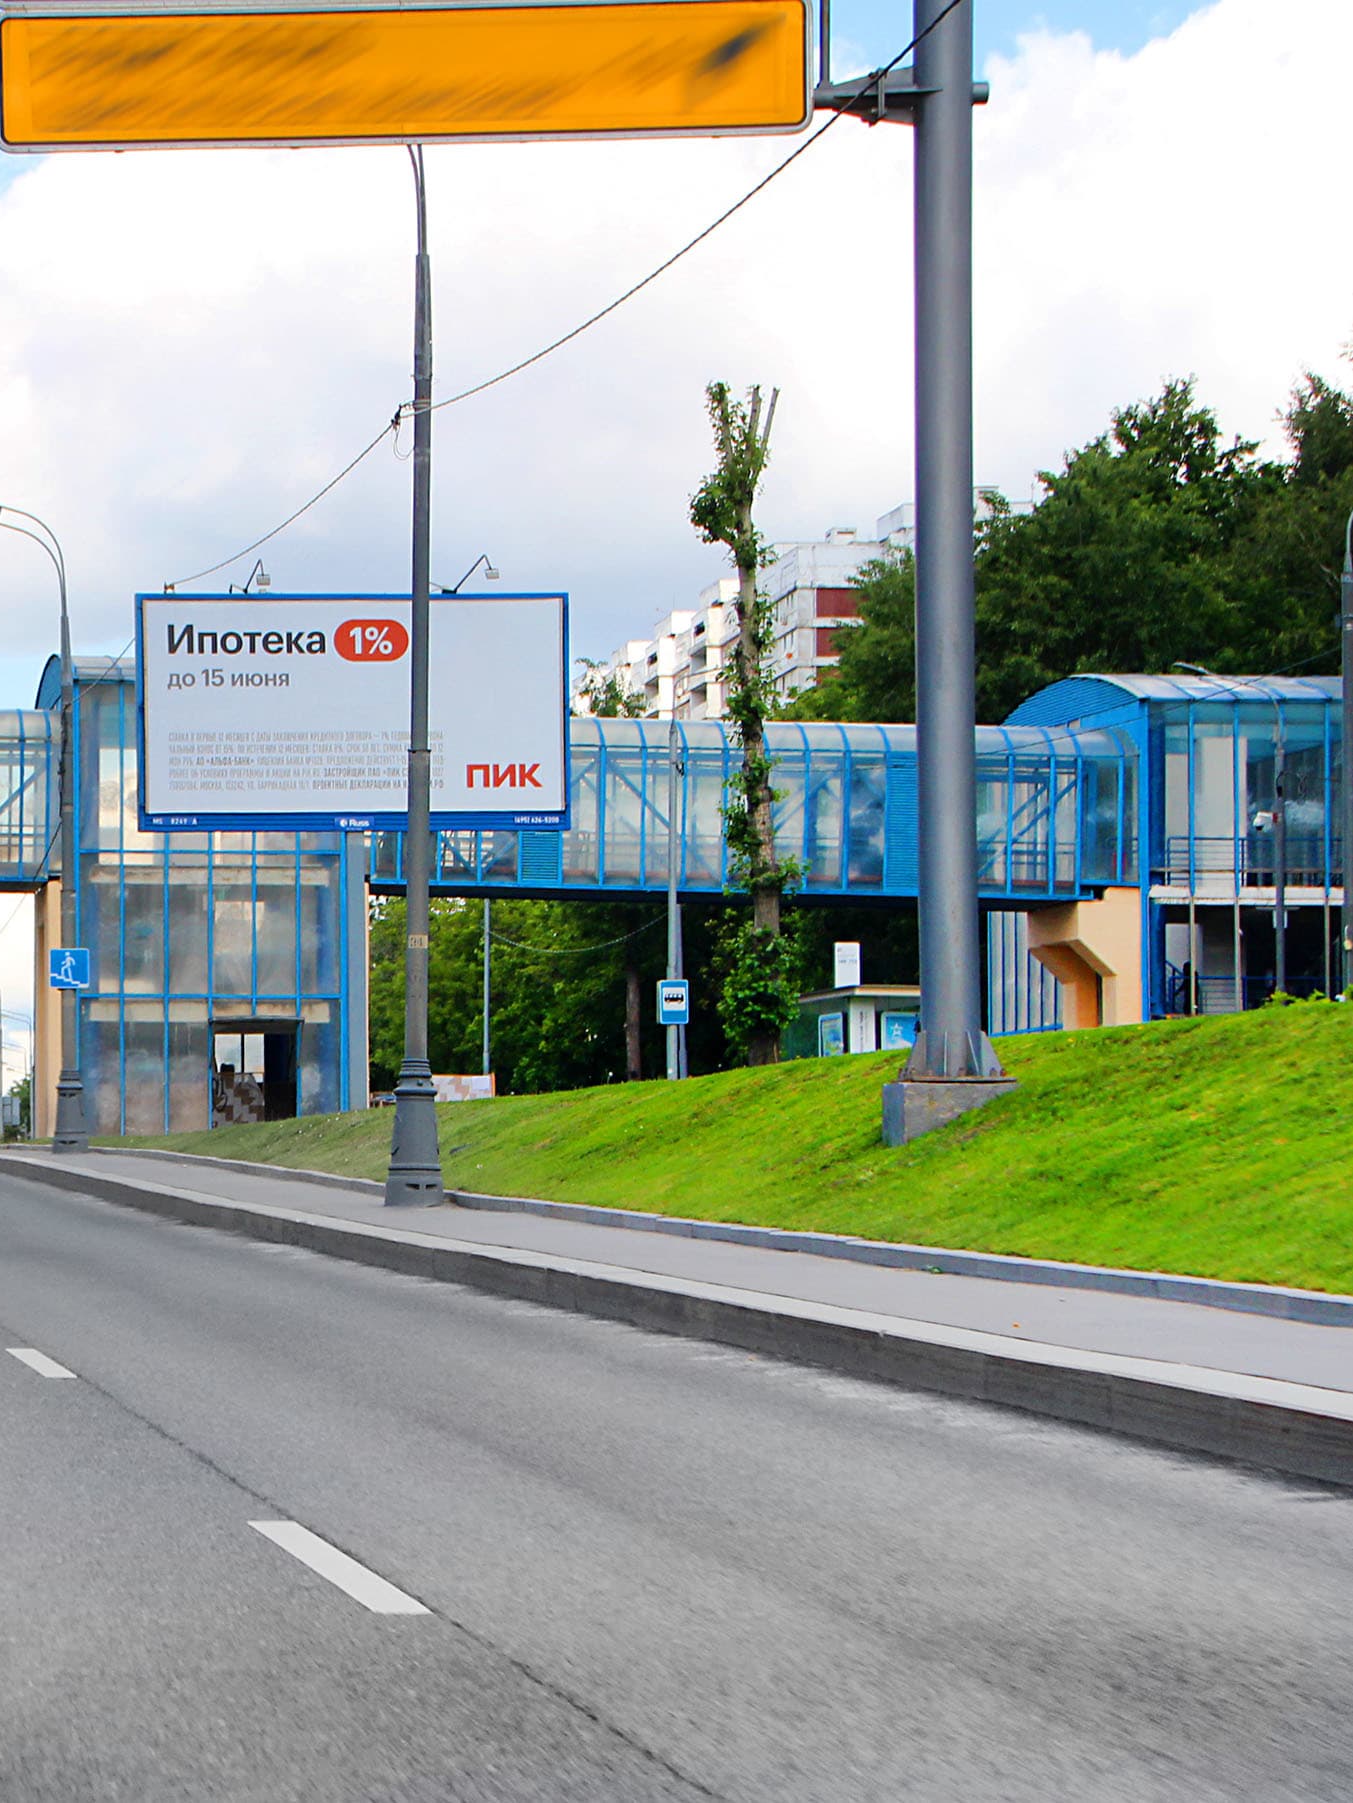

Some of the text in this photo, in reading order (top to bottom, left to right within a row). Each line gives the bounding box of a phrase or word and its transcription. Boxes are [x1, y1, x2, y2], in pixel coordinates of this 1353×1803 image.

[166, 623, 393, 655] Ипотека 1%
[167, 669, 290, 690] до 15 июня
[465, 762, 543, 789] ПИК
